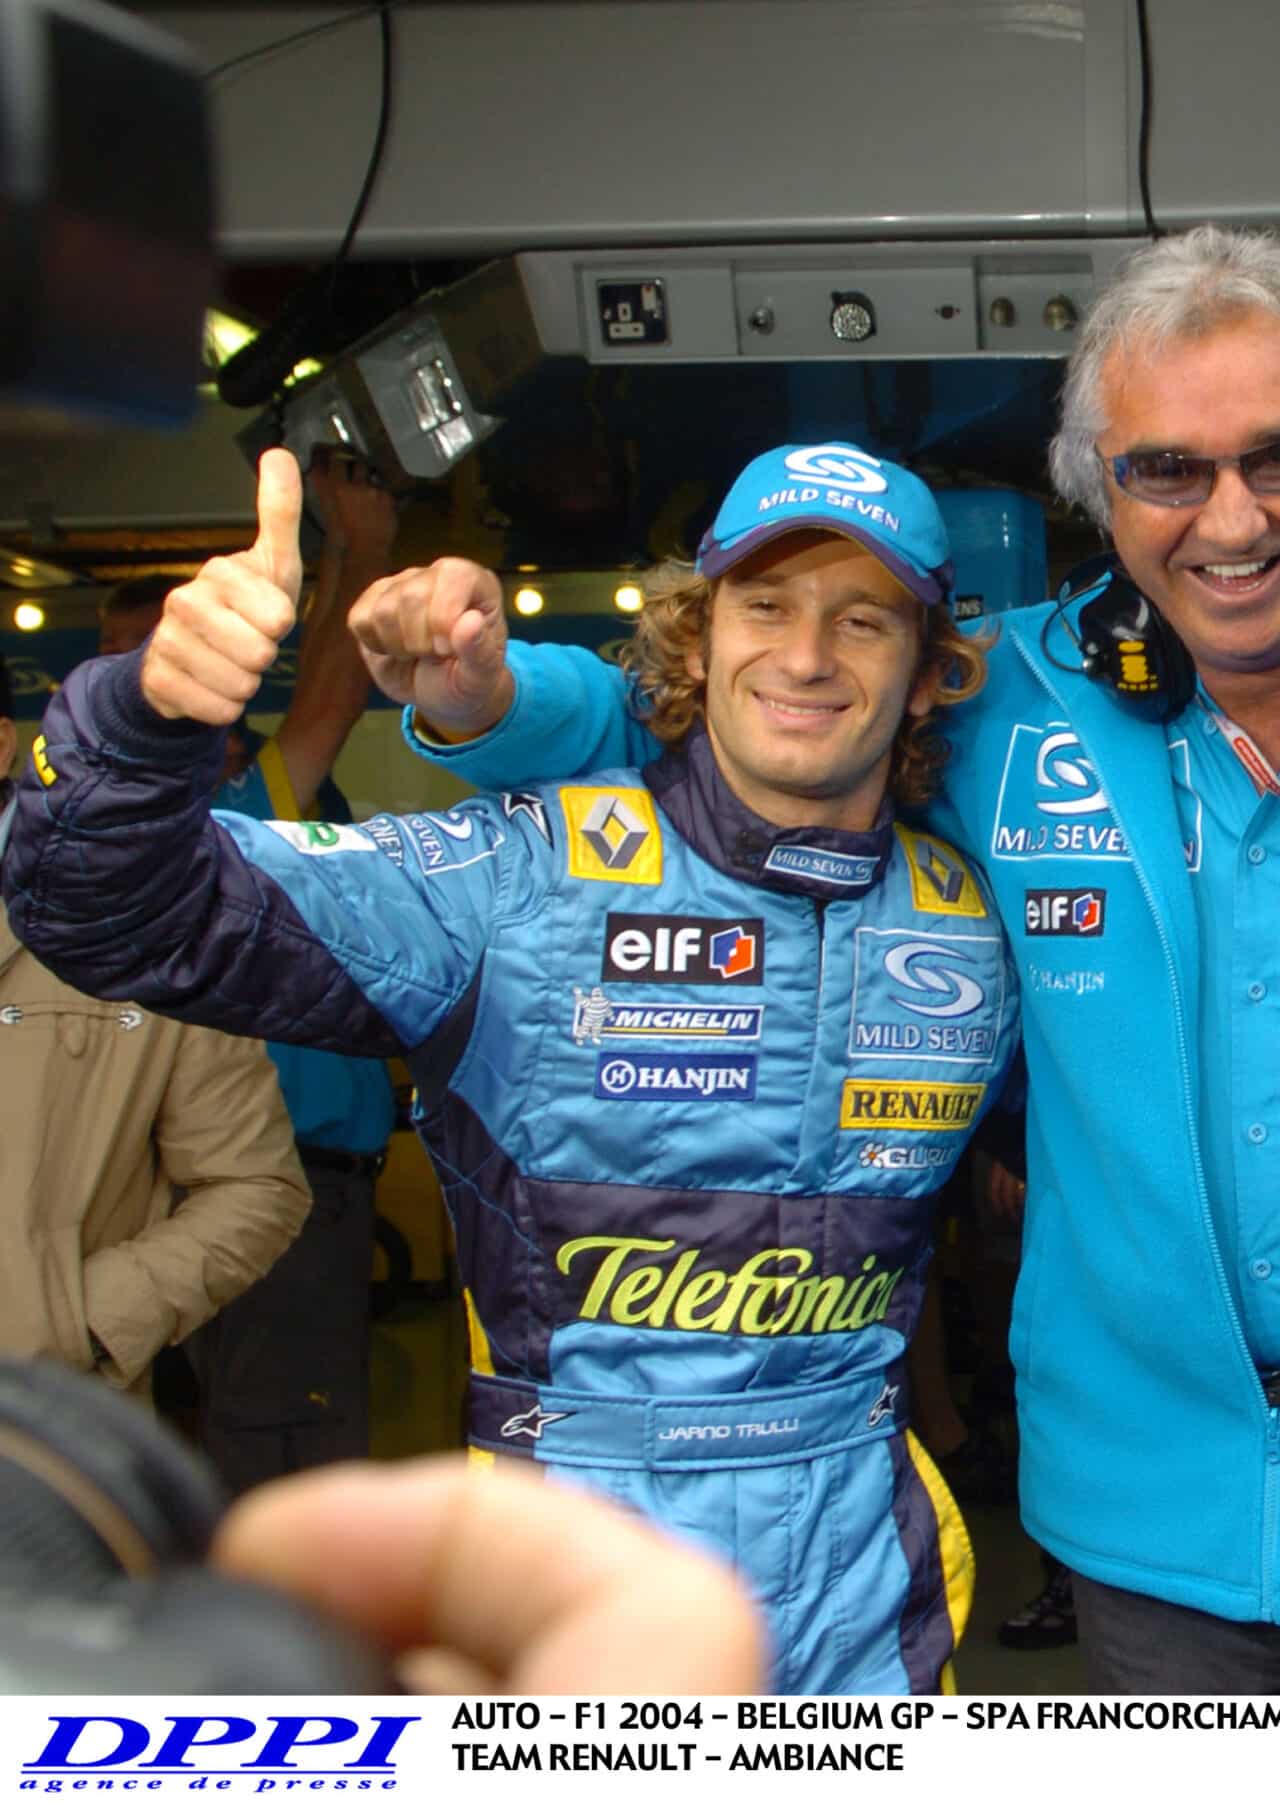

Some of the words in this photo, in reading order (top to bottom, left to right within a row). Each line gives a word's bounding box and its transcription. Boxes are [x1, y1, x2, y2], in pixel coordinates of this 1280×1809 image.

[758, 487, 819, 512] MILD
[826, 490, 901, 533] SEVEN
[774, 850, 809, 868] MILD
[1026, 896, 1069, 930] elf
[610, 927, 702, 972] elf
[615, 1010, 755, 1030] MICHELIN
[856, 1023, 921, 1049] MILD
[927, 1025, 995, 1052] SEVEN
[637, 1067, 751, 1096] HANJIN
[850, 1090, 979, 1121] RENAULT
[658, 1425, 731, 1441] JARNO
